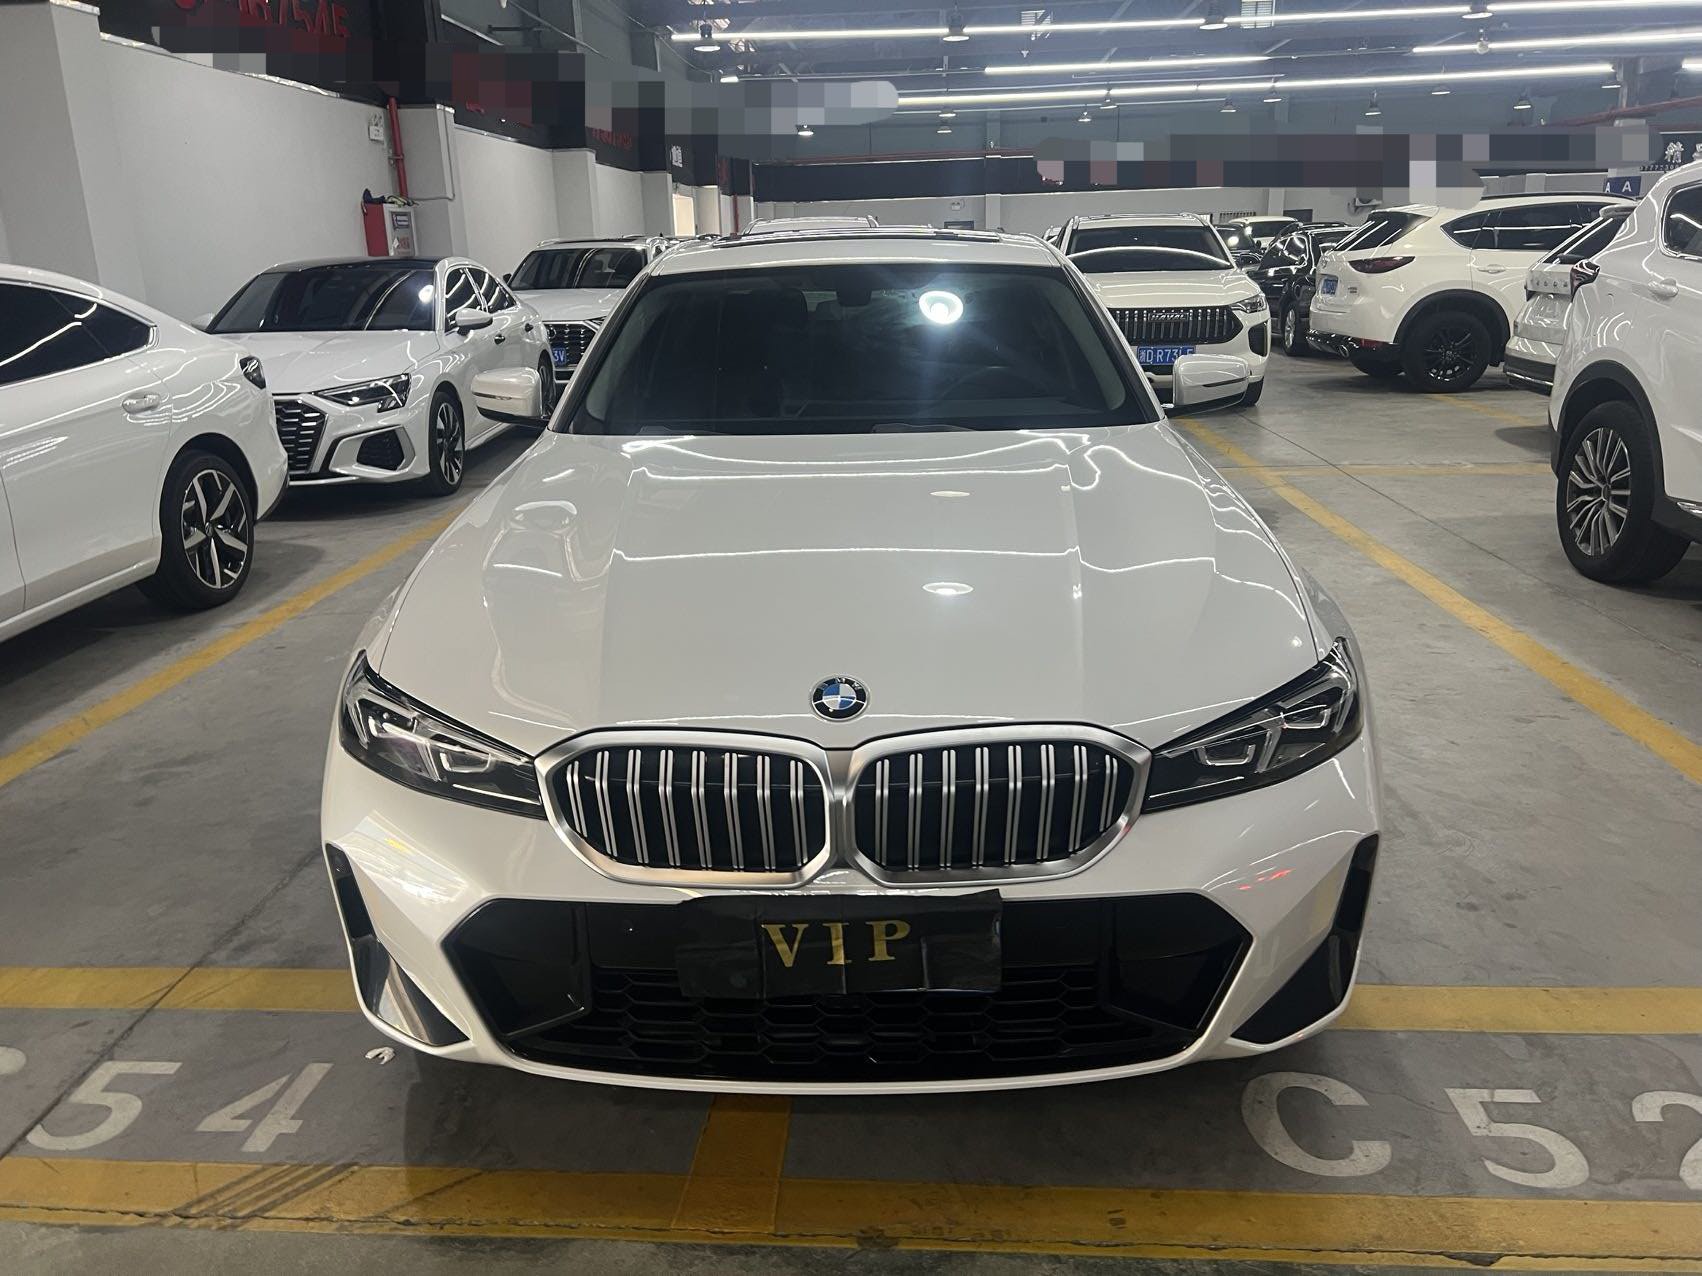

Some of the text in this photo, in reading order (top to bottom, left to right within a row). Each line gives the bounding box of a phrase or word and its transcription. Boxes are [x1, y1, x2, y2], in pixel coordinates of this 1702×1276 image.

[1621, 181, 1632, 193] A
[761, 919, 912, 968] VIP
[0, 1046, 335, 1153] 54
